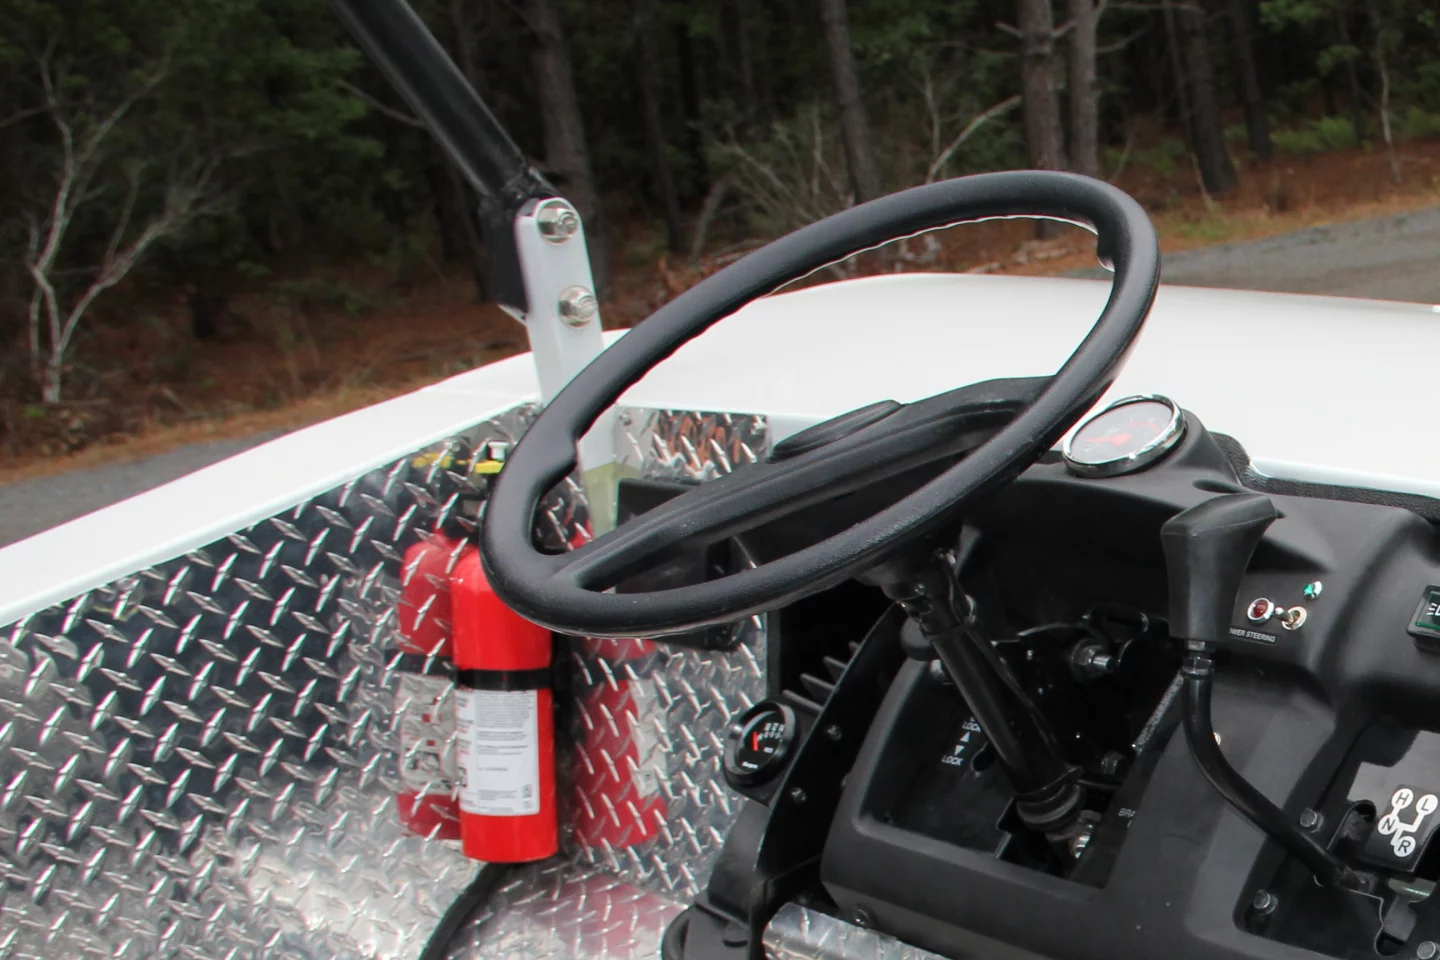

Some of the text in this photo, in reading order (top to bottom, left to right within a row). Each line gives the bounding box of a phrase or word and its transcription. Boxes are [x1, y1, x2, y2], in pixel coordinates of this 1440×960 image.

[1245, 630, 1276, 643] STEERING
[940, 754, 964, 766] LOCK
[1395, 792, 1410, 806] H
[1421, 798, 1429, 811] L
[1381, 817, 1396, 831] N
[1397, 840, 1411, 853] R
